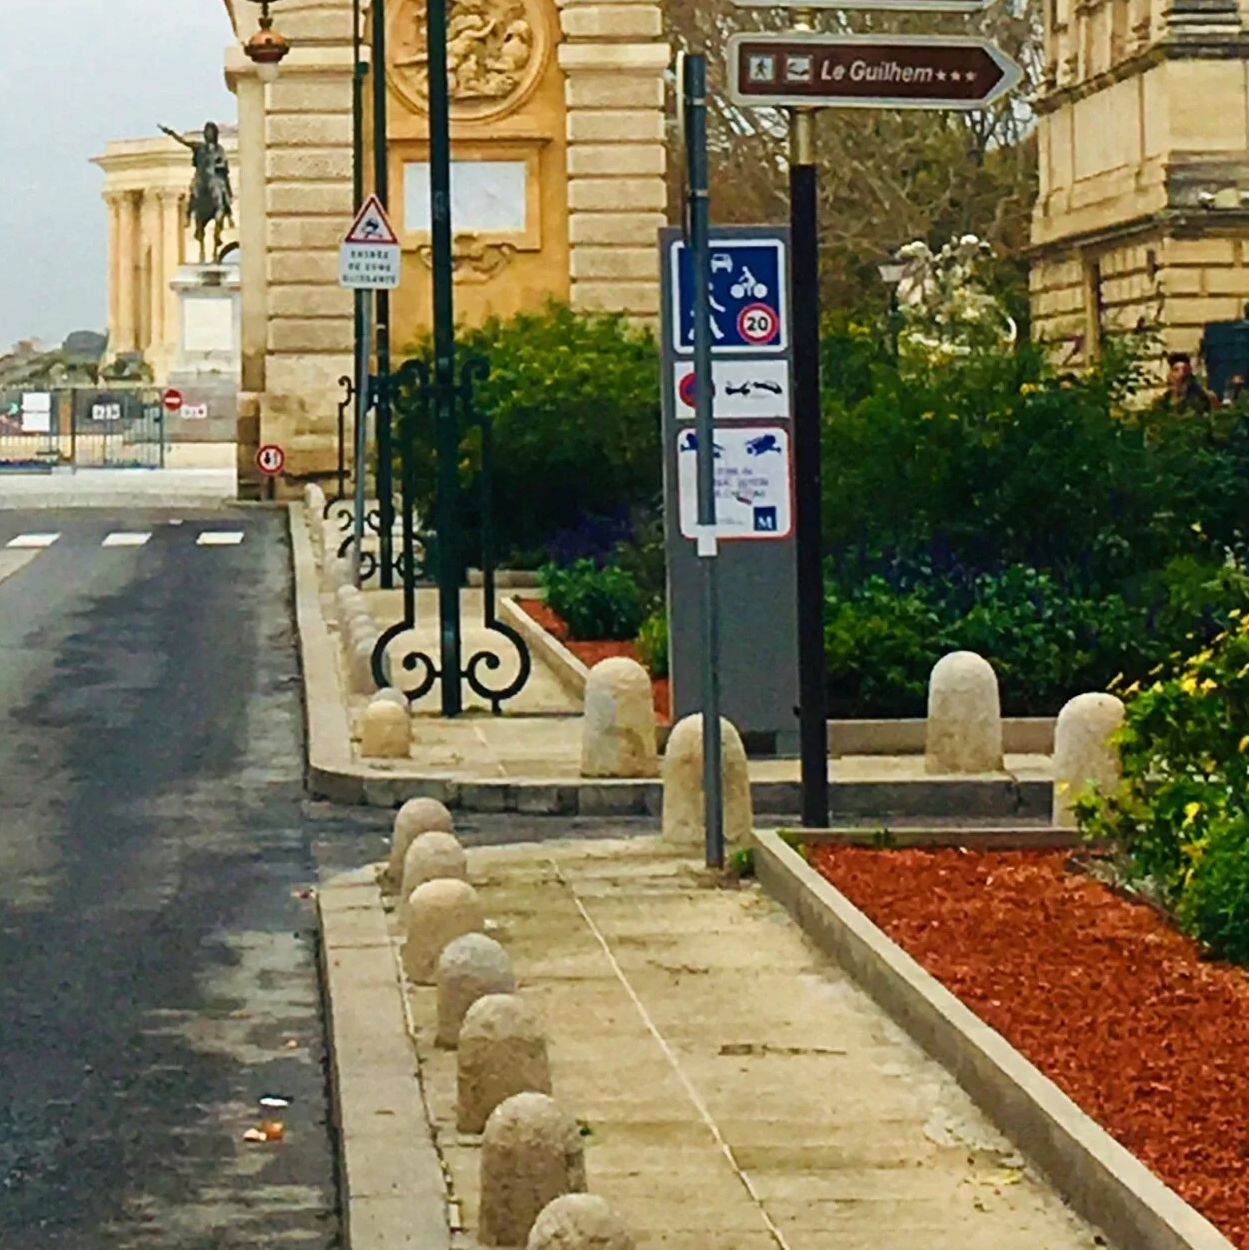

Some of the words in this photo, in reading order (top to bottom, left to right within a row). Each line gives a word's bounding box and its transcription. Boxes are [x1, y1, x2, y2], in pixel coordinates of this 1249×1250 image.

[820, 59, 845, 81] Le
[849, 59, 934, 83] Guilhem
[747, 316, 769, 332] 20
[757, 515, 773, 529] M
